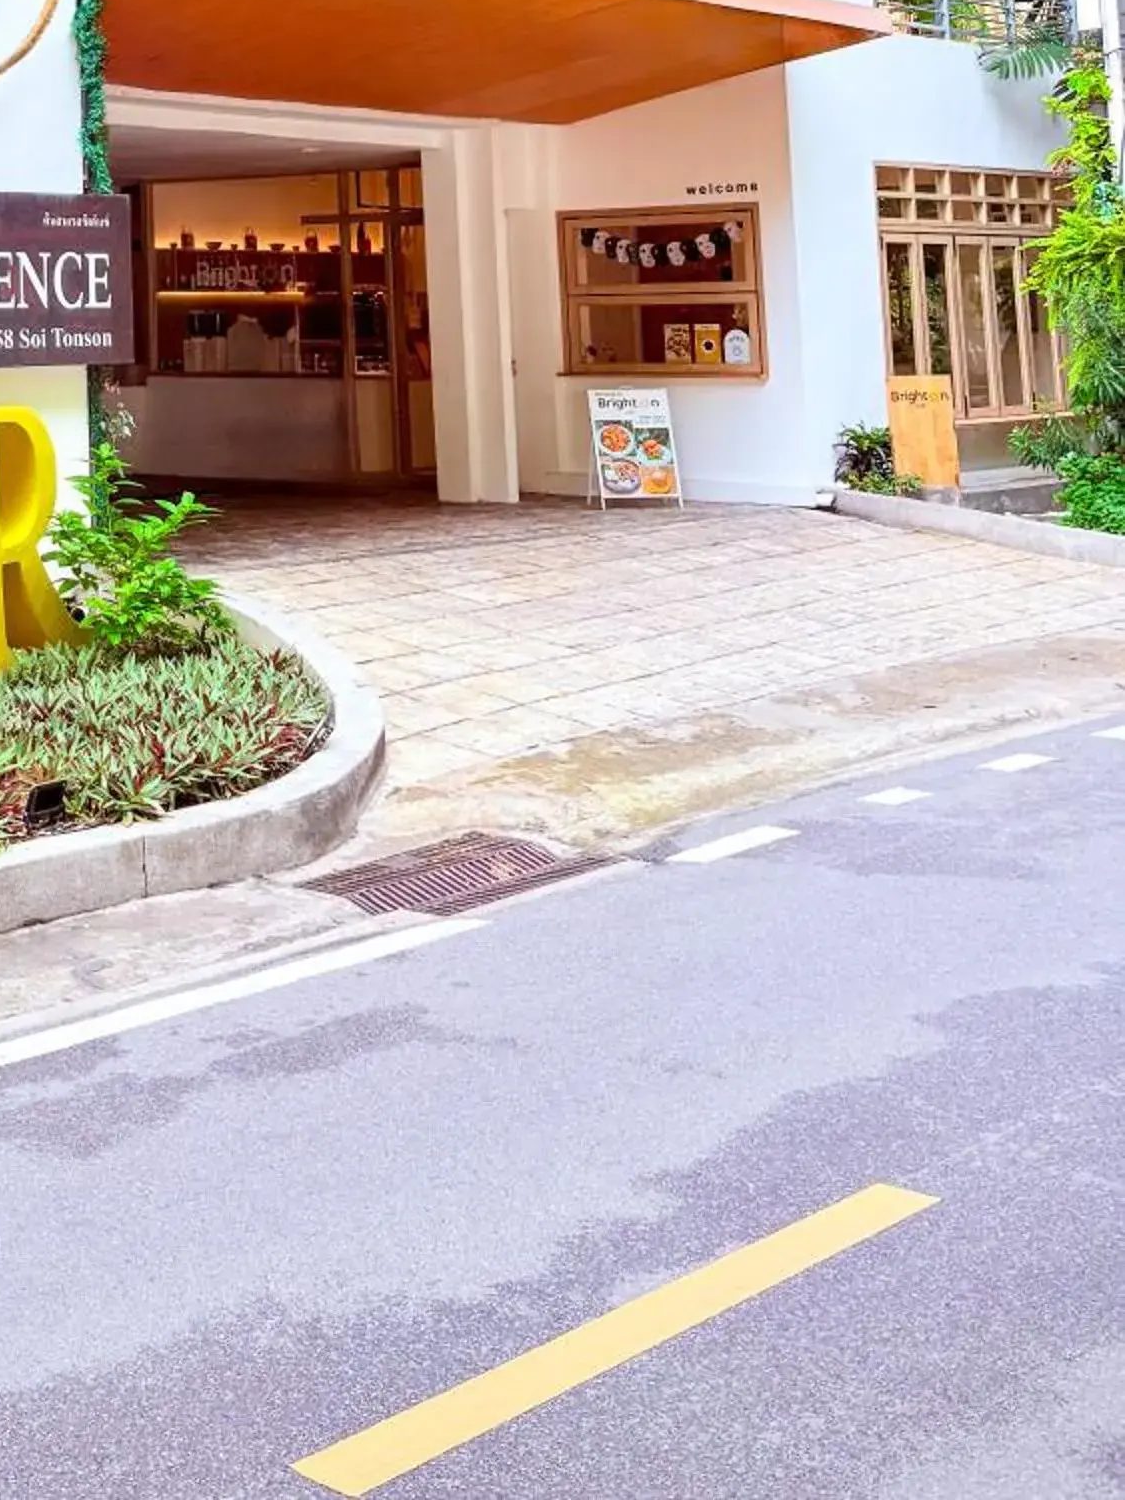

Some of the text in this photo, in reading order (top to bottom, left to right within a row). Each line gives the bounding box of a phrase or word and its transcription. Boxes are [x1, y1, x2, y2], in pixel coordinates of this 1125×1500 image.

[686, 182, 758, 195] welcome
[18, 327, 47, 349] Soi
[50, 326, 113, 348] Tonson
[597, 397, 661, 410] Brightn
